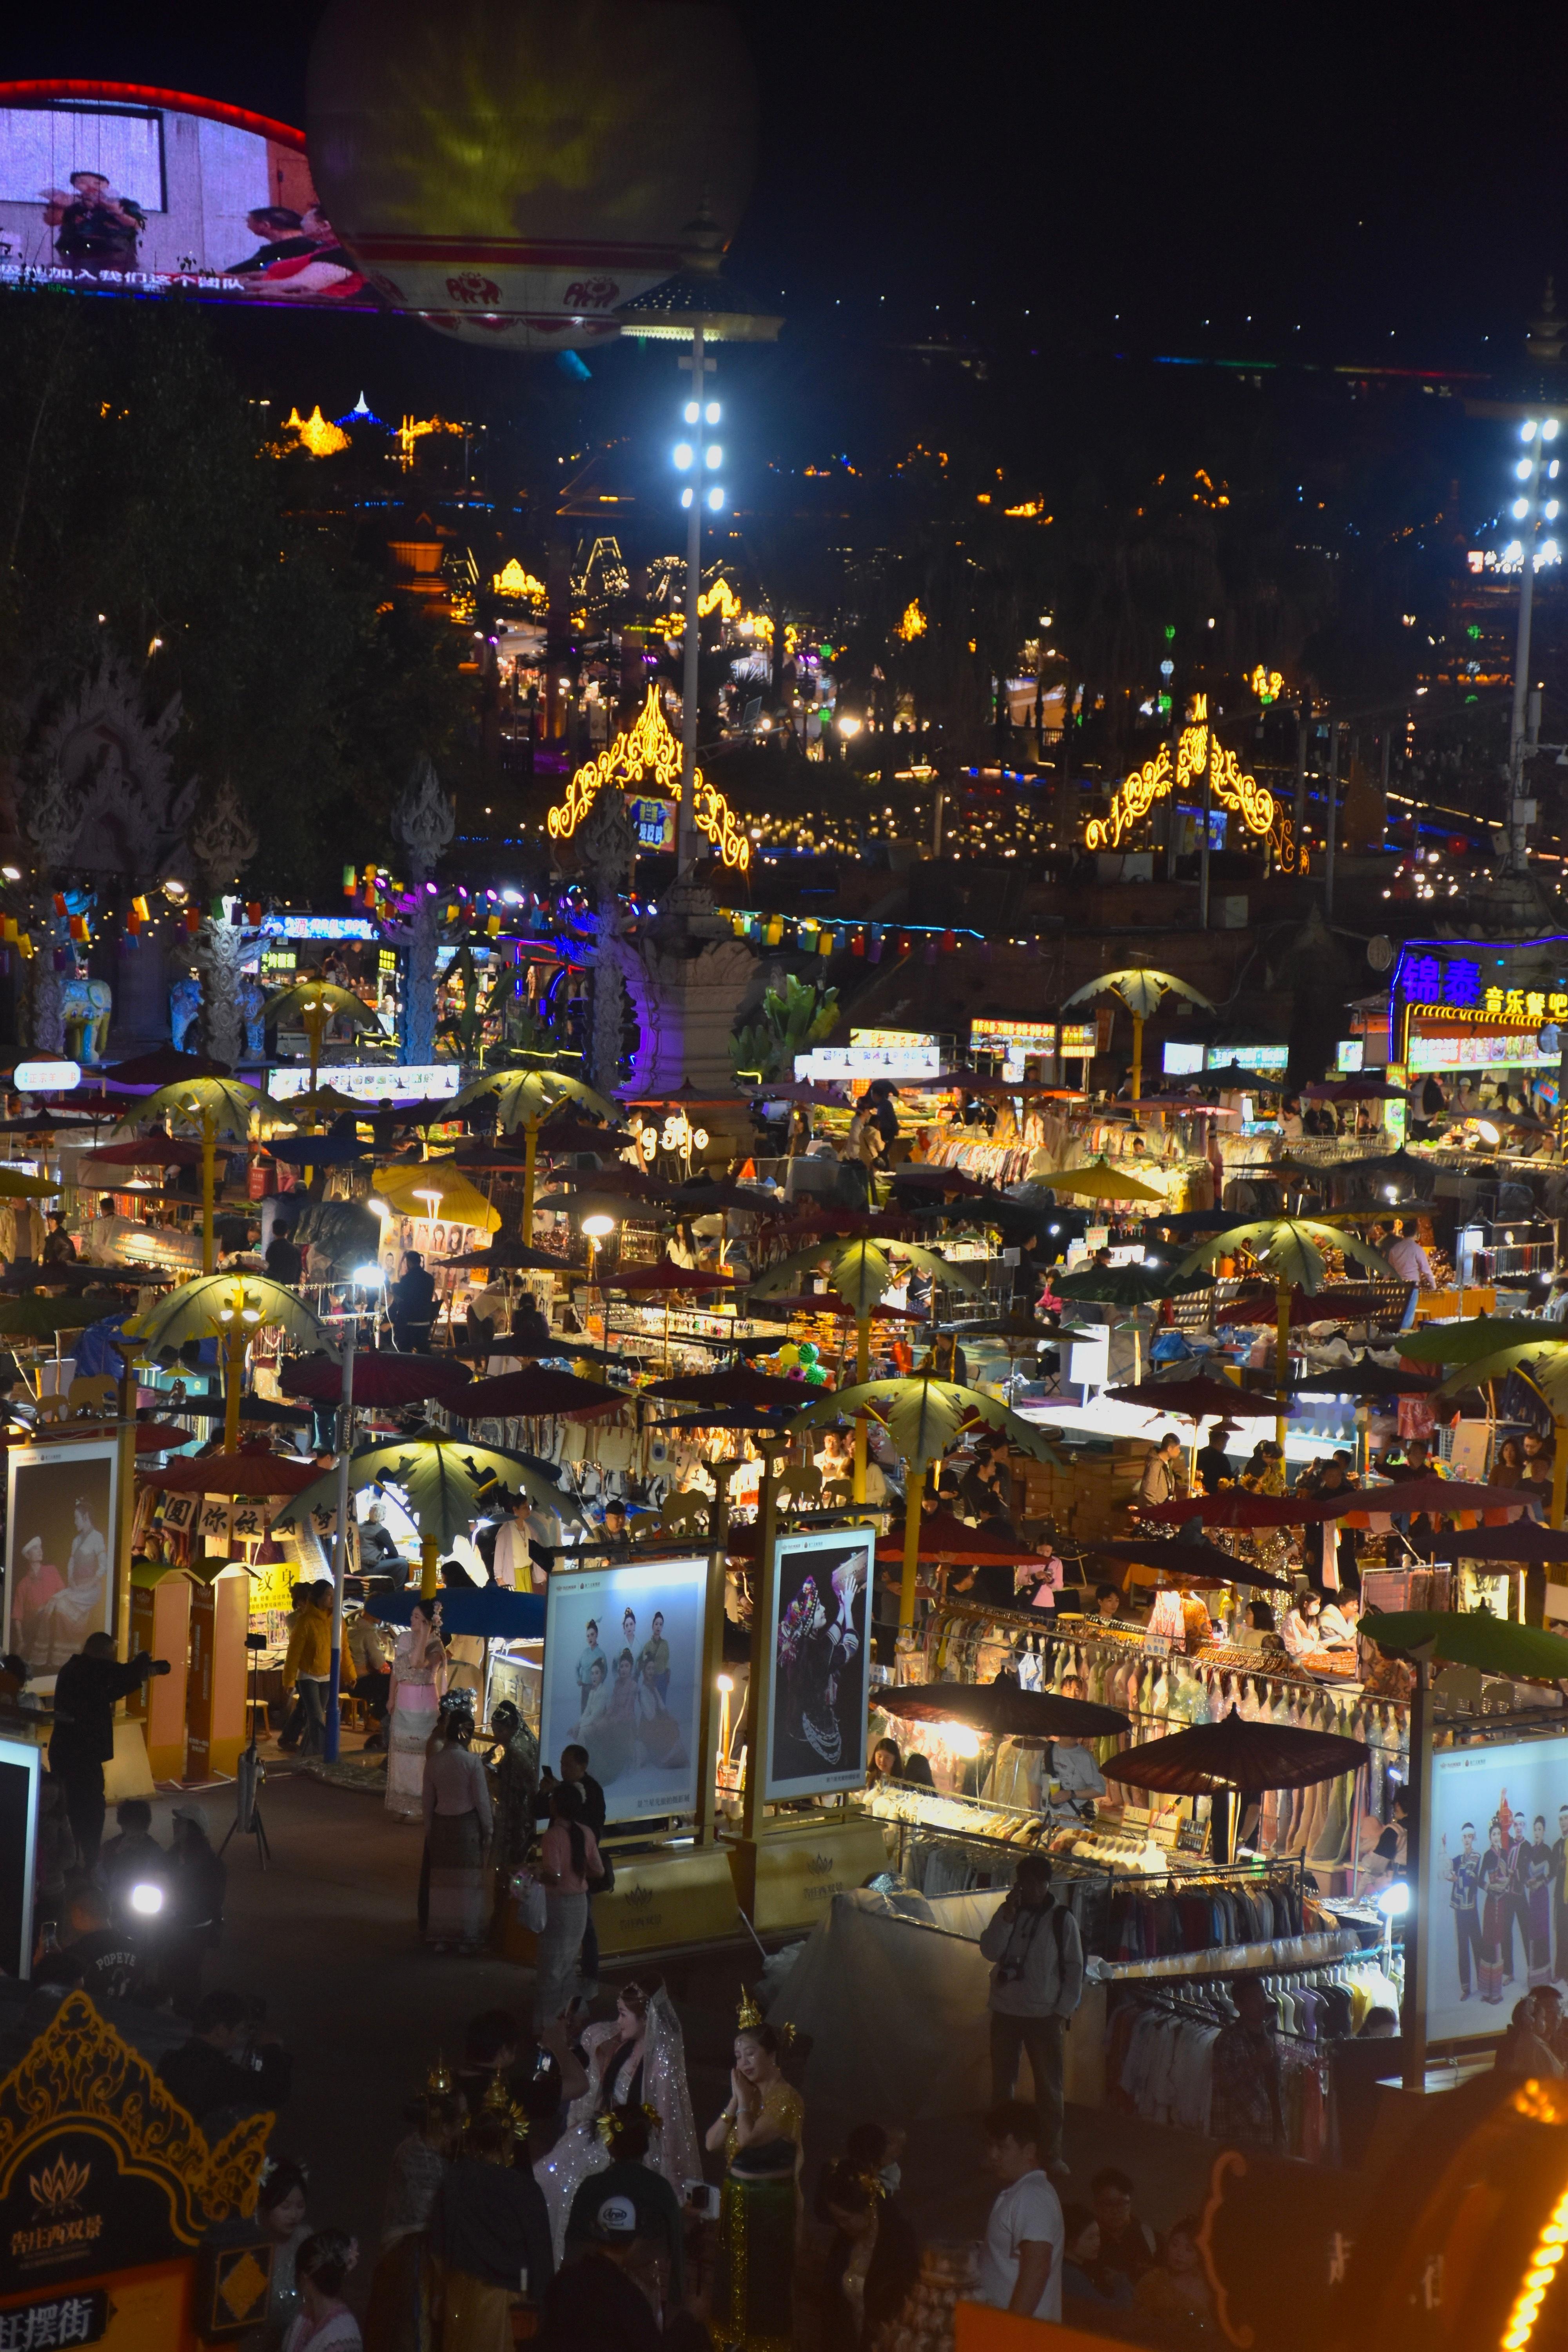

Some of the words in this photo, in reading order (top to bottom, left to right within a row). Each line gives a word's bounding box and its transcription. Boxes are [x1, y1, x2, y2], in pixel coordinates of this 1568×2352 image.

[1401, 954, 1481, 1007] 锦泰
[1485, 986, 1568, 1018] 音乐餐吧
[29, 1072, 76, 1083] 正宗羊串
[257, 1568, 295, 1593] 纹身
[96, 1952, 136, 1971] POPEYE
[11, 2214, 104, 2256] 告庄西双景
